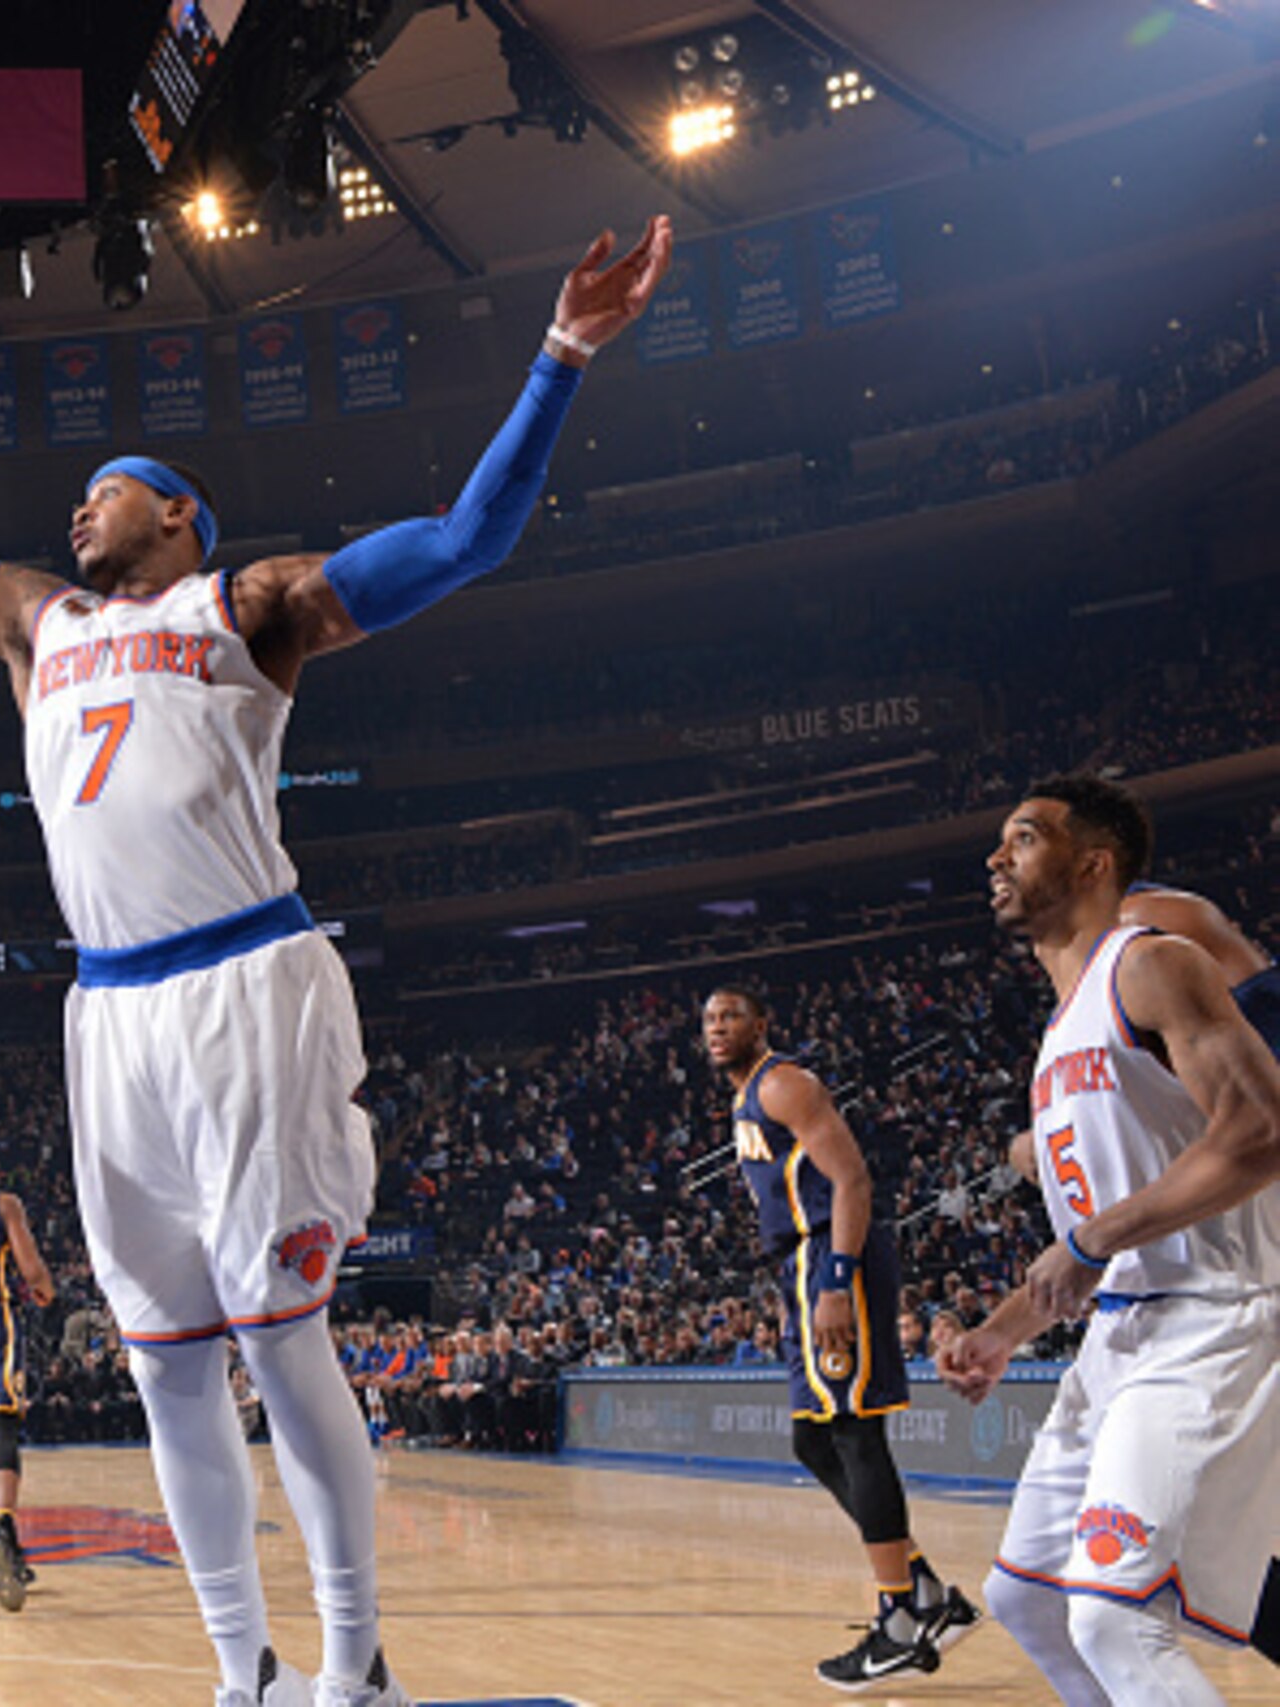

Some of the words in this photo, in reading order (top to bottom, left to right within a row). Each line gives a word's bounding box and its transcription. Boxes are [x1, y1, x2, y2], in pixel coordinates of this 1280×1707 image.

[110, 630, 212, 685] YORK
[73, 697, 136, 807] 7
[761, 710, 828, 744] BLUE
[837, 697, 921, 735] SEATS
[1046, 1123, 1094, 1219] 5
